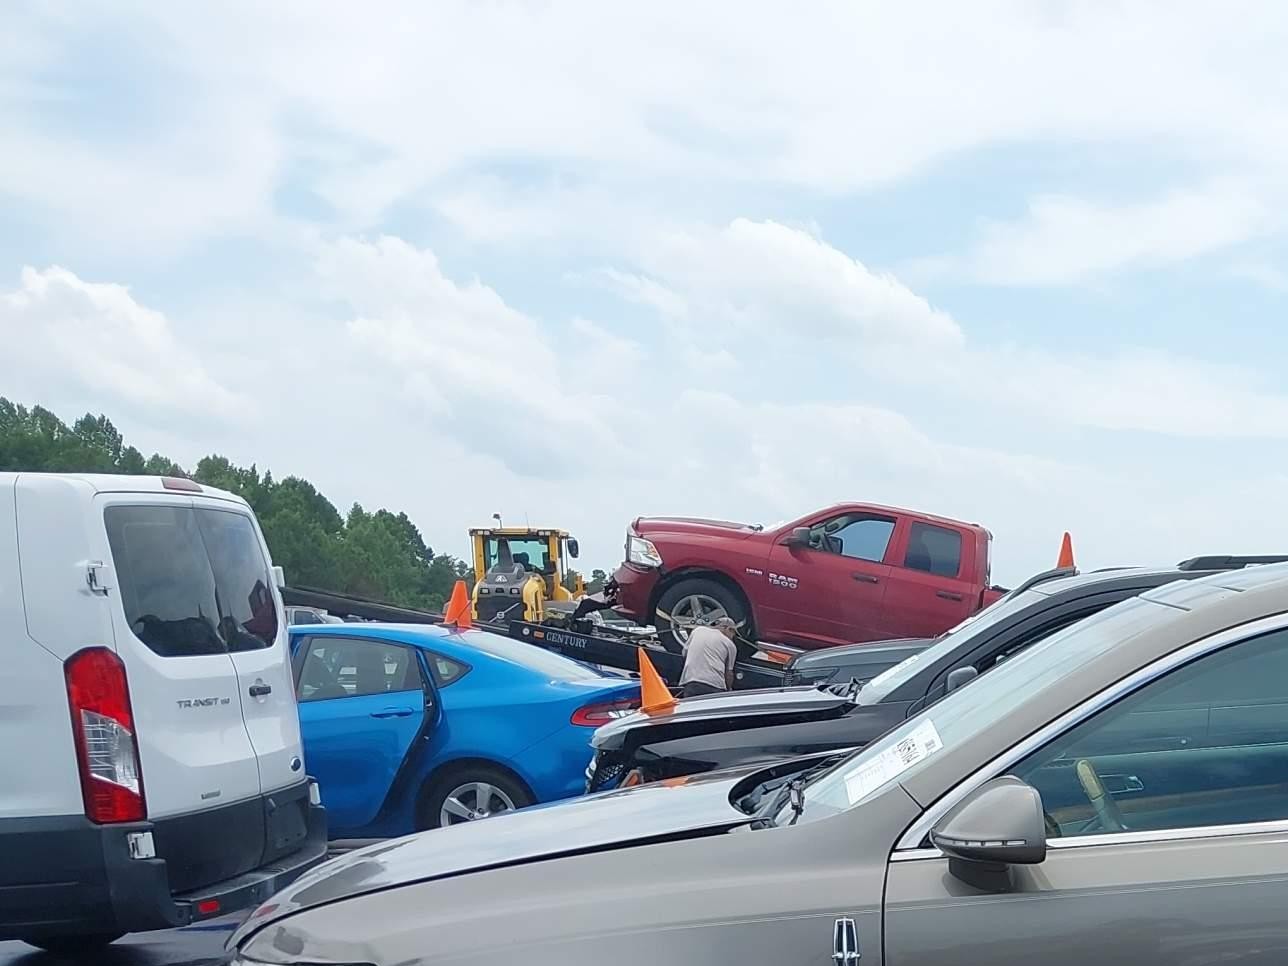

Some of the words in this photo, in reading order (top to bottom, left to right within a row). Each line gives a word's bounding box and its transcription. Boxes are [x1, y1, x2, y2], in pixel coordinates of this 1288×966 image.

[768, 572, 798, 583] RAM
[768, 578, 797, 589] 1500
[546, 631, 588, 649] CENTURY
[176, 697, 219, 708] TRANSIT
